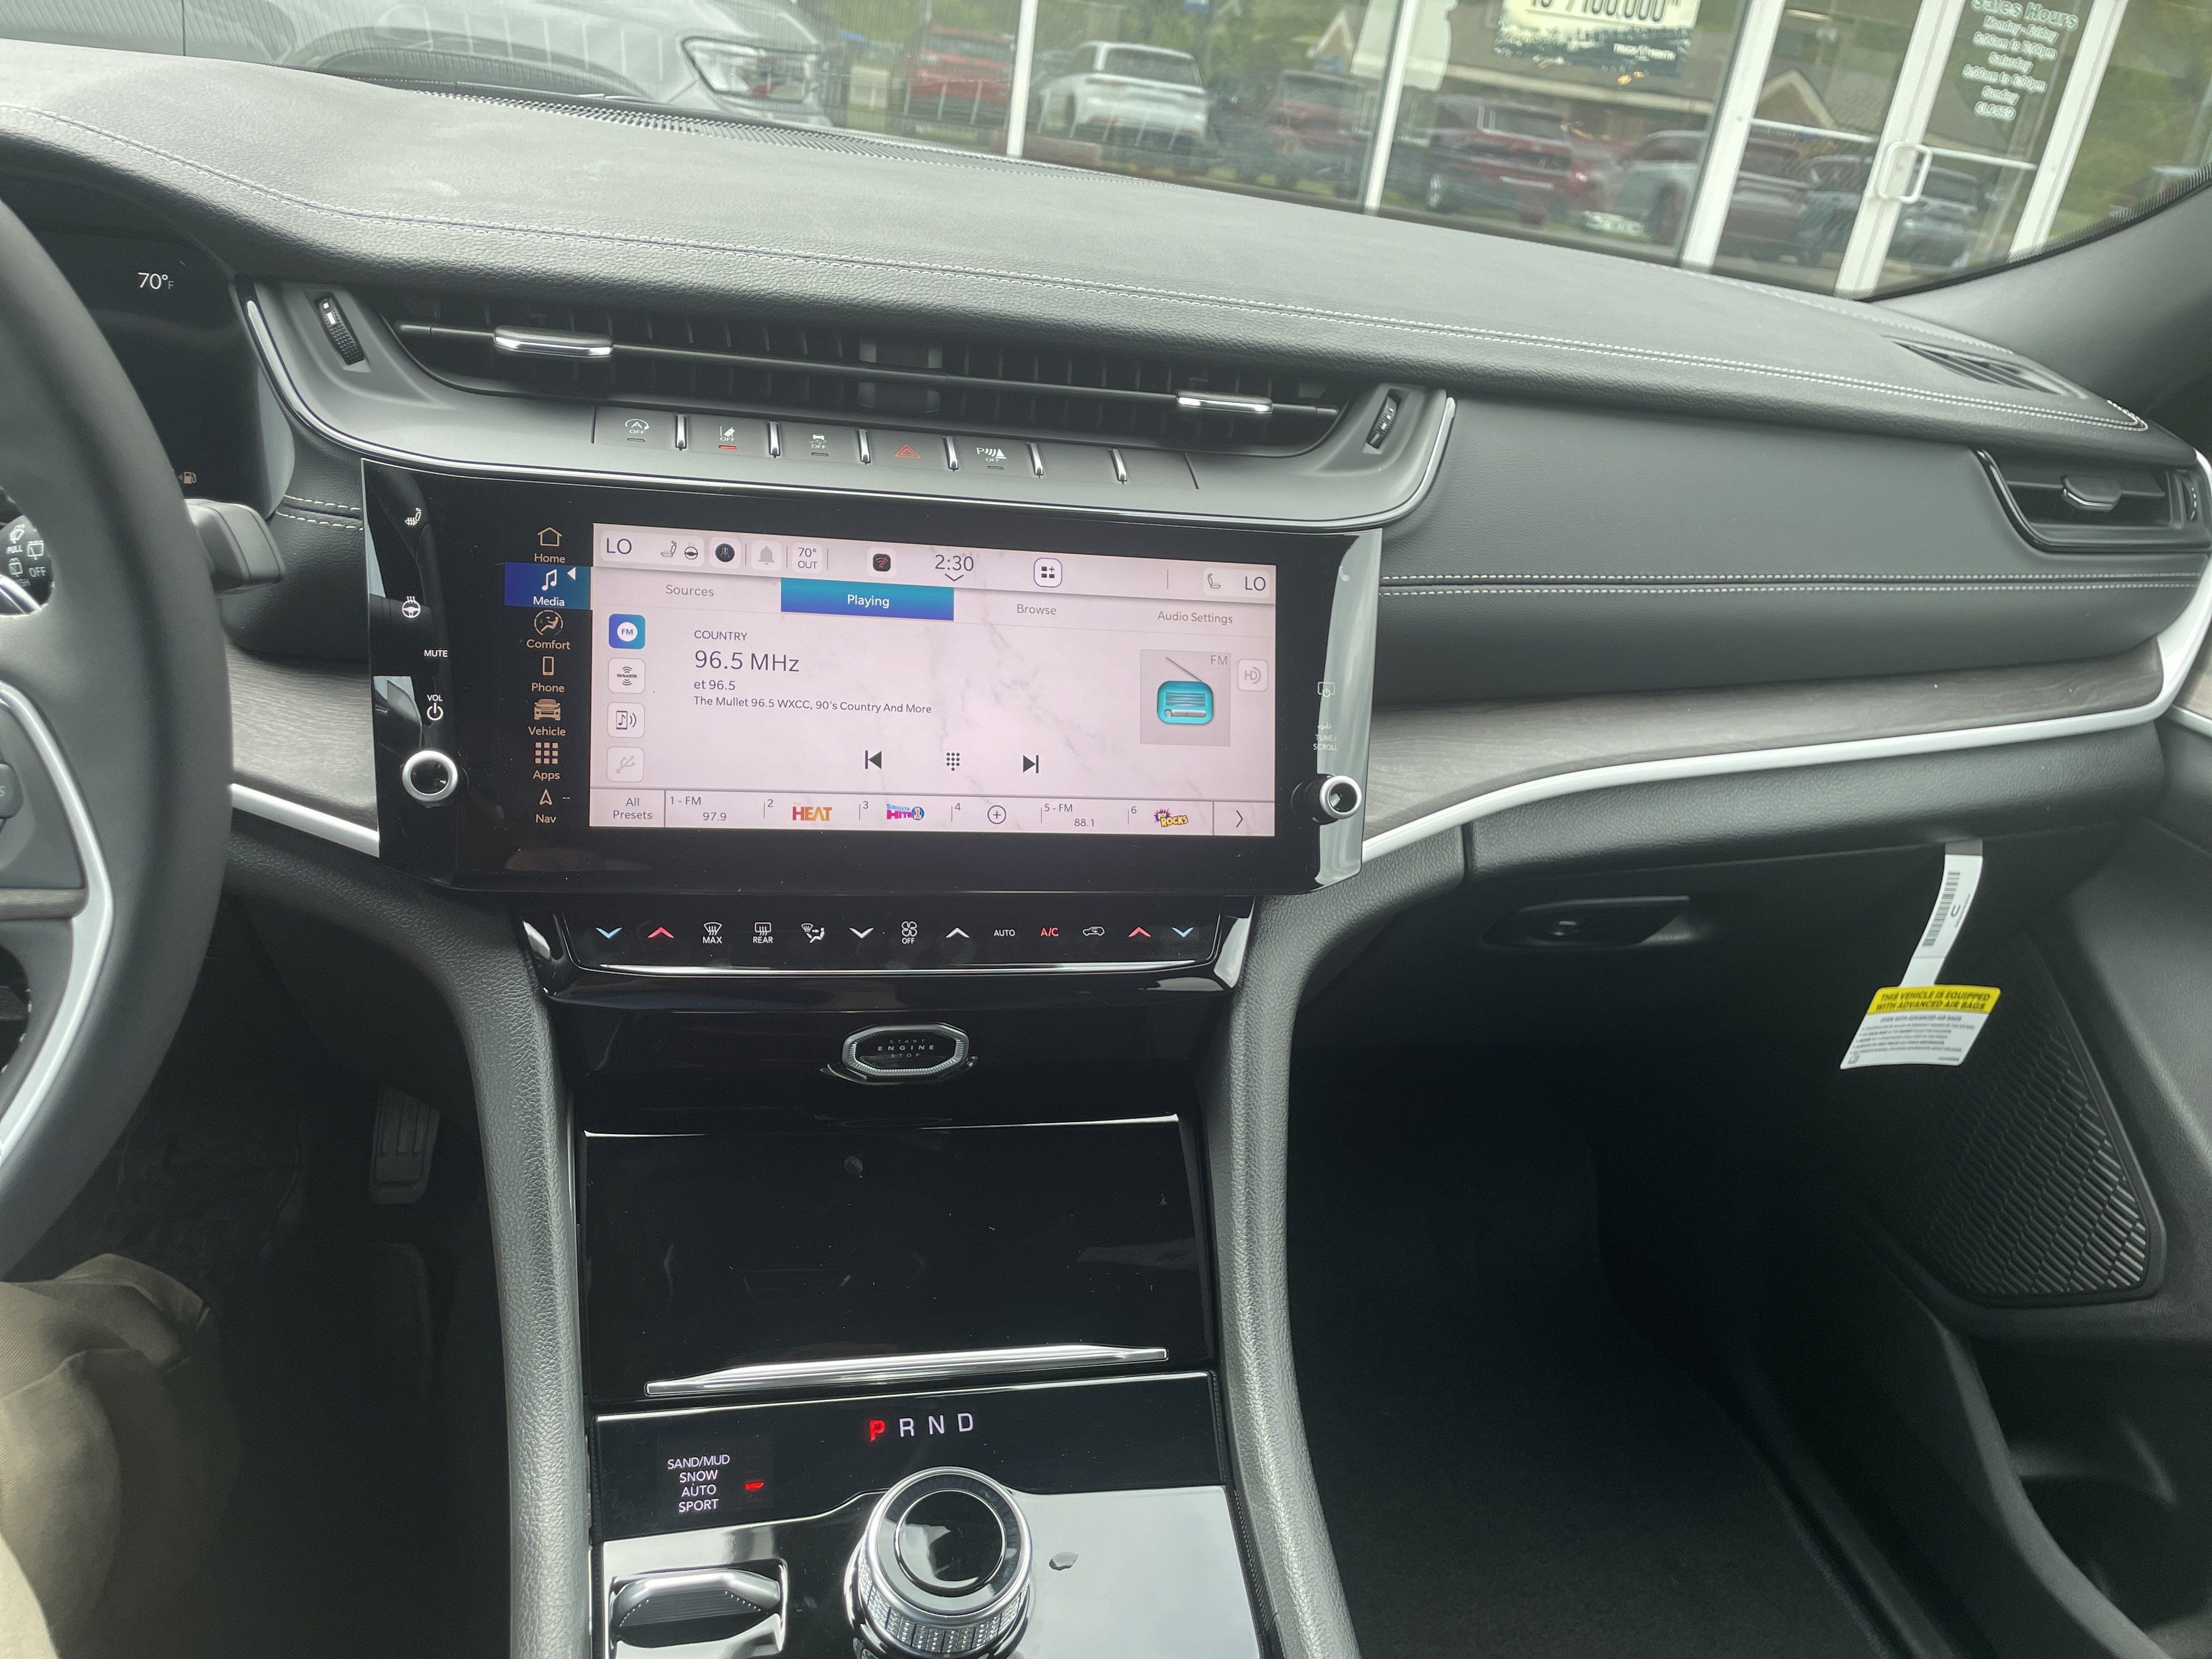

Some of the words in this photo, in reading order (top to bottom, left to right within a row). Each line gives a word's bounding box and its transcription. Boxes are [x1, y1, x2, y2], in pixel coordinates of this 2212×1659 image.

[1971, 0, 2023, 19] Sales
[2024, 2, 2079, 29] Hours
[1983, 15, 2022, 37] Monday
[2028, 24, 2058, 44] Friday
[2010, 38, 2021, 52] to
[1988, 52, 2033, 74] Saturday
[2000, 72, 2011, 86] to
[1982, 85, 2020, 106] Sunday
[1975, 101, 2016, 121] CLOSED
[606, 538, 632, 555] LO
[798, 547, 817, 557] 70°
[534, 553, 566, 563] Home
[934, 554, 974, 572] 2:30
[798, 560, 817, 570] OUT
[29, 566, 46, 578] OFF
[1245, 576, 1266, 591] LO
[665, 584, 714, 597] Sources
[533, 596, 565, 607] Media
[847, 594, 890, 608] Playing
[1017, 604, 1057, 615] Browse
[1157, 611, 1188, 622] Audio
[1191, 612, 1233, 624] Settings
[694, 630, 748, 641] COUNTRY
[526, 639, 571, 650] Comfort
[695, 650, 743, 669] 96.5
[751, 653, 799, 672] MHz
[1211, 654, 1228, 665] FM
[531, 683, 565, 693] Phone
[694, 680, 706, 689] et
[709, 680, 736, 690] 96.5
[693, 696, 713, 705] The
[716, 697, 749, 707] Mullet
[751, 698, 775, 708] 96.5
[777, 699, 813, 710] WXCC,
[816, 701, 838, 710] 90's
[840, 702, 881, 713] Country
[883, 703, 903, 713] And
[906, 704, 932, 713] More
[528, 726, 566, 736] Vehicle
[533, 770, 560, 781] Apps
[625, 797, 640, 807] All
[670, 796, 675, 805] 1
[685, 797, 702, 806] FM
[768, 799, 774, 808] 2
[862, 801, 869, 810] 3
[955, 803, 961, 811] 4
[1044, 804, 1050, 812] 5
[1059, 804, 1073, 813] FM
[1131, 806, 1137, 815] 6
[535, 814, 556, 823] Nav
[613, 809, 653, 820] Presets
[702, 811, 727, 821] 97.9
[792, 806, 832, 821] HEAT
[1074, 819, 1094, 827] 88.1
[1160, 815, 1188, 827] ROCKS
[1040, 927, 1059, 936] A/C
[1881, 992, 1899, 1001] THIS
[1900, 991, 1934, 1000] VEHICLE
[1936, 991, 1944, 1000] IS
[1945, 992, 1990, 1001] EQUIPPED
[1876, 1002, 1896, 1011] WITH
[1897, 1000, 1943, 1009] ADVANCED
[1944, 1001, 1957, 1009] AIR
[1960, 1001, 1985, 1010] BAGS
[870, 1420, 885, 1441] P
[899, 1418, 915, 1437] R
[928, 1415, 944, 1435] N
[958, 1413, 974, 1432] D
[668, 1454, 730, 1469] SAND/MUD
[680, 1469, 718, 1482] SNOW
[681, 1485, 716, 1497] AUTO
[679, 1498, 719, 1513] SPORT
